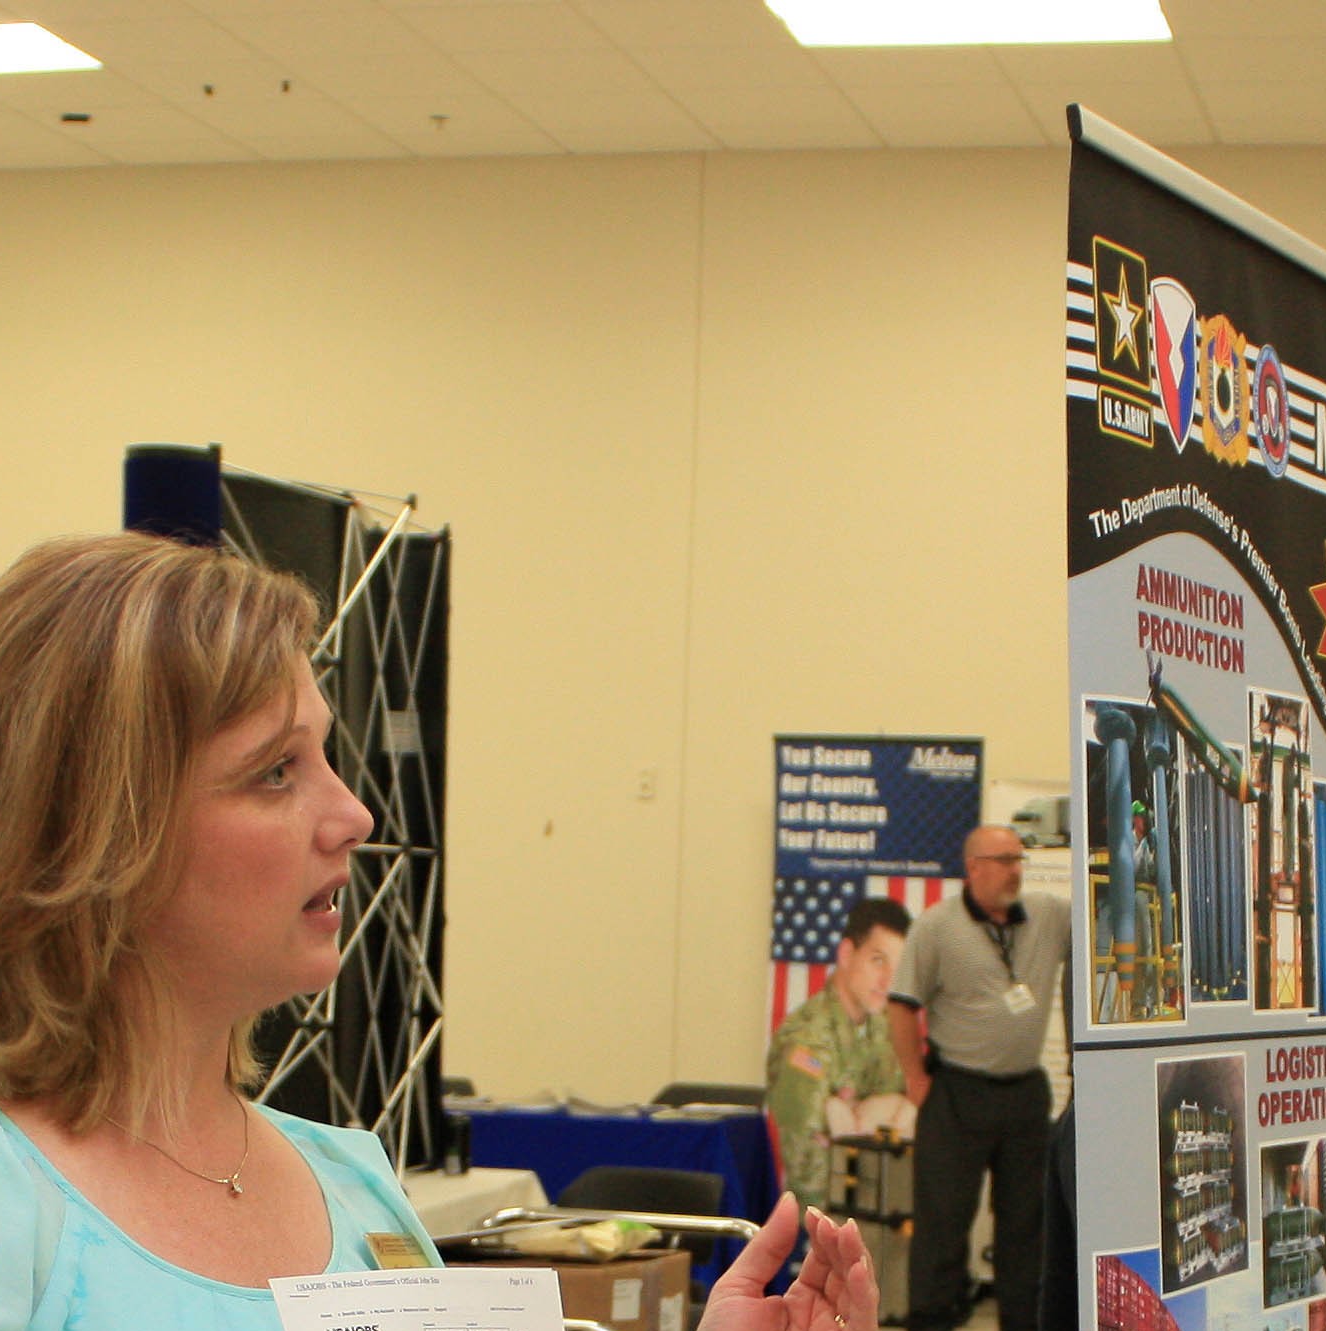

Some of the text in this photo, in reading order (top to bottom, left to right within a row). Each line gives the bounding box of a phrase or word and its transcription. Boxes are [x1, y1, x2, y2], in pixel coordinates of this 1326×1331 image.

[1088, 509, 1121, 538] The
[1121, 484, 1181, 524] Department
[1181, 483, 1193, 507] of
[1192, 485, 1239, 543] Defense's
[1240, 528, 1280, 597] Premier
[1136, 563, 1245, 630] AMMUNITION
[1138, 611, 1245, 674] PRODUCTION
[813, 745, 872, 769] Secure
[828, 801, 888, 825] Secure
